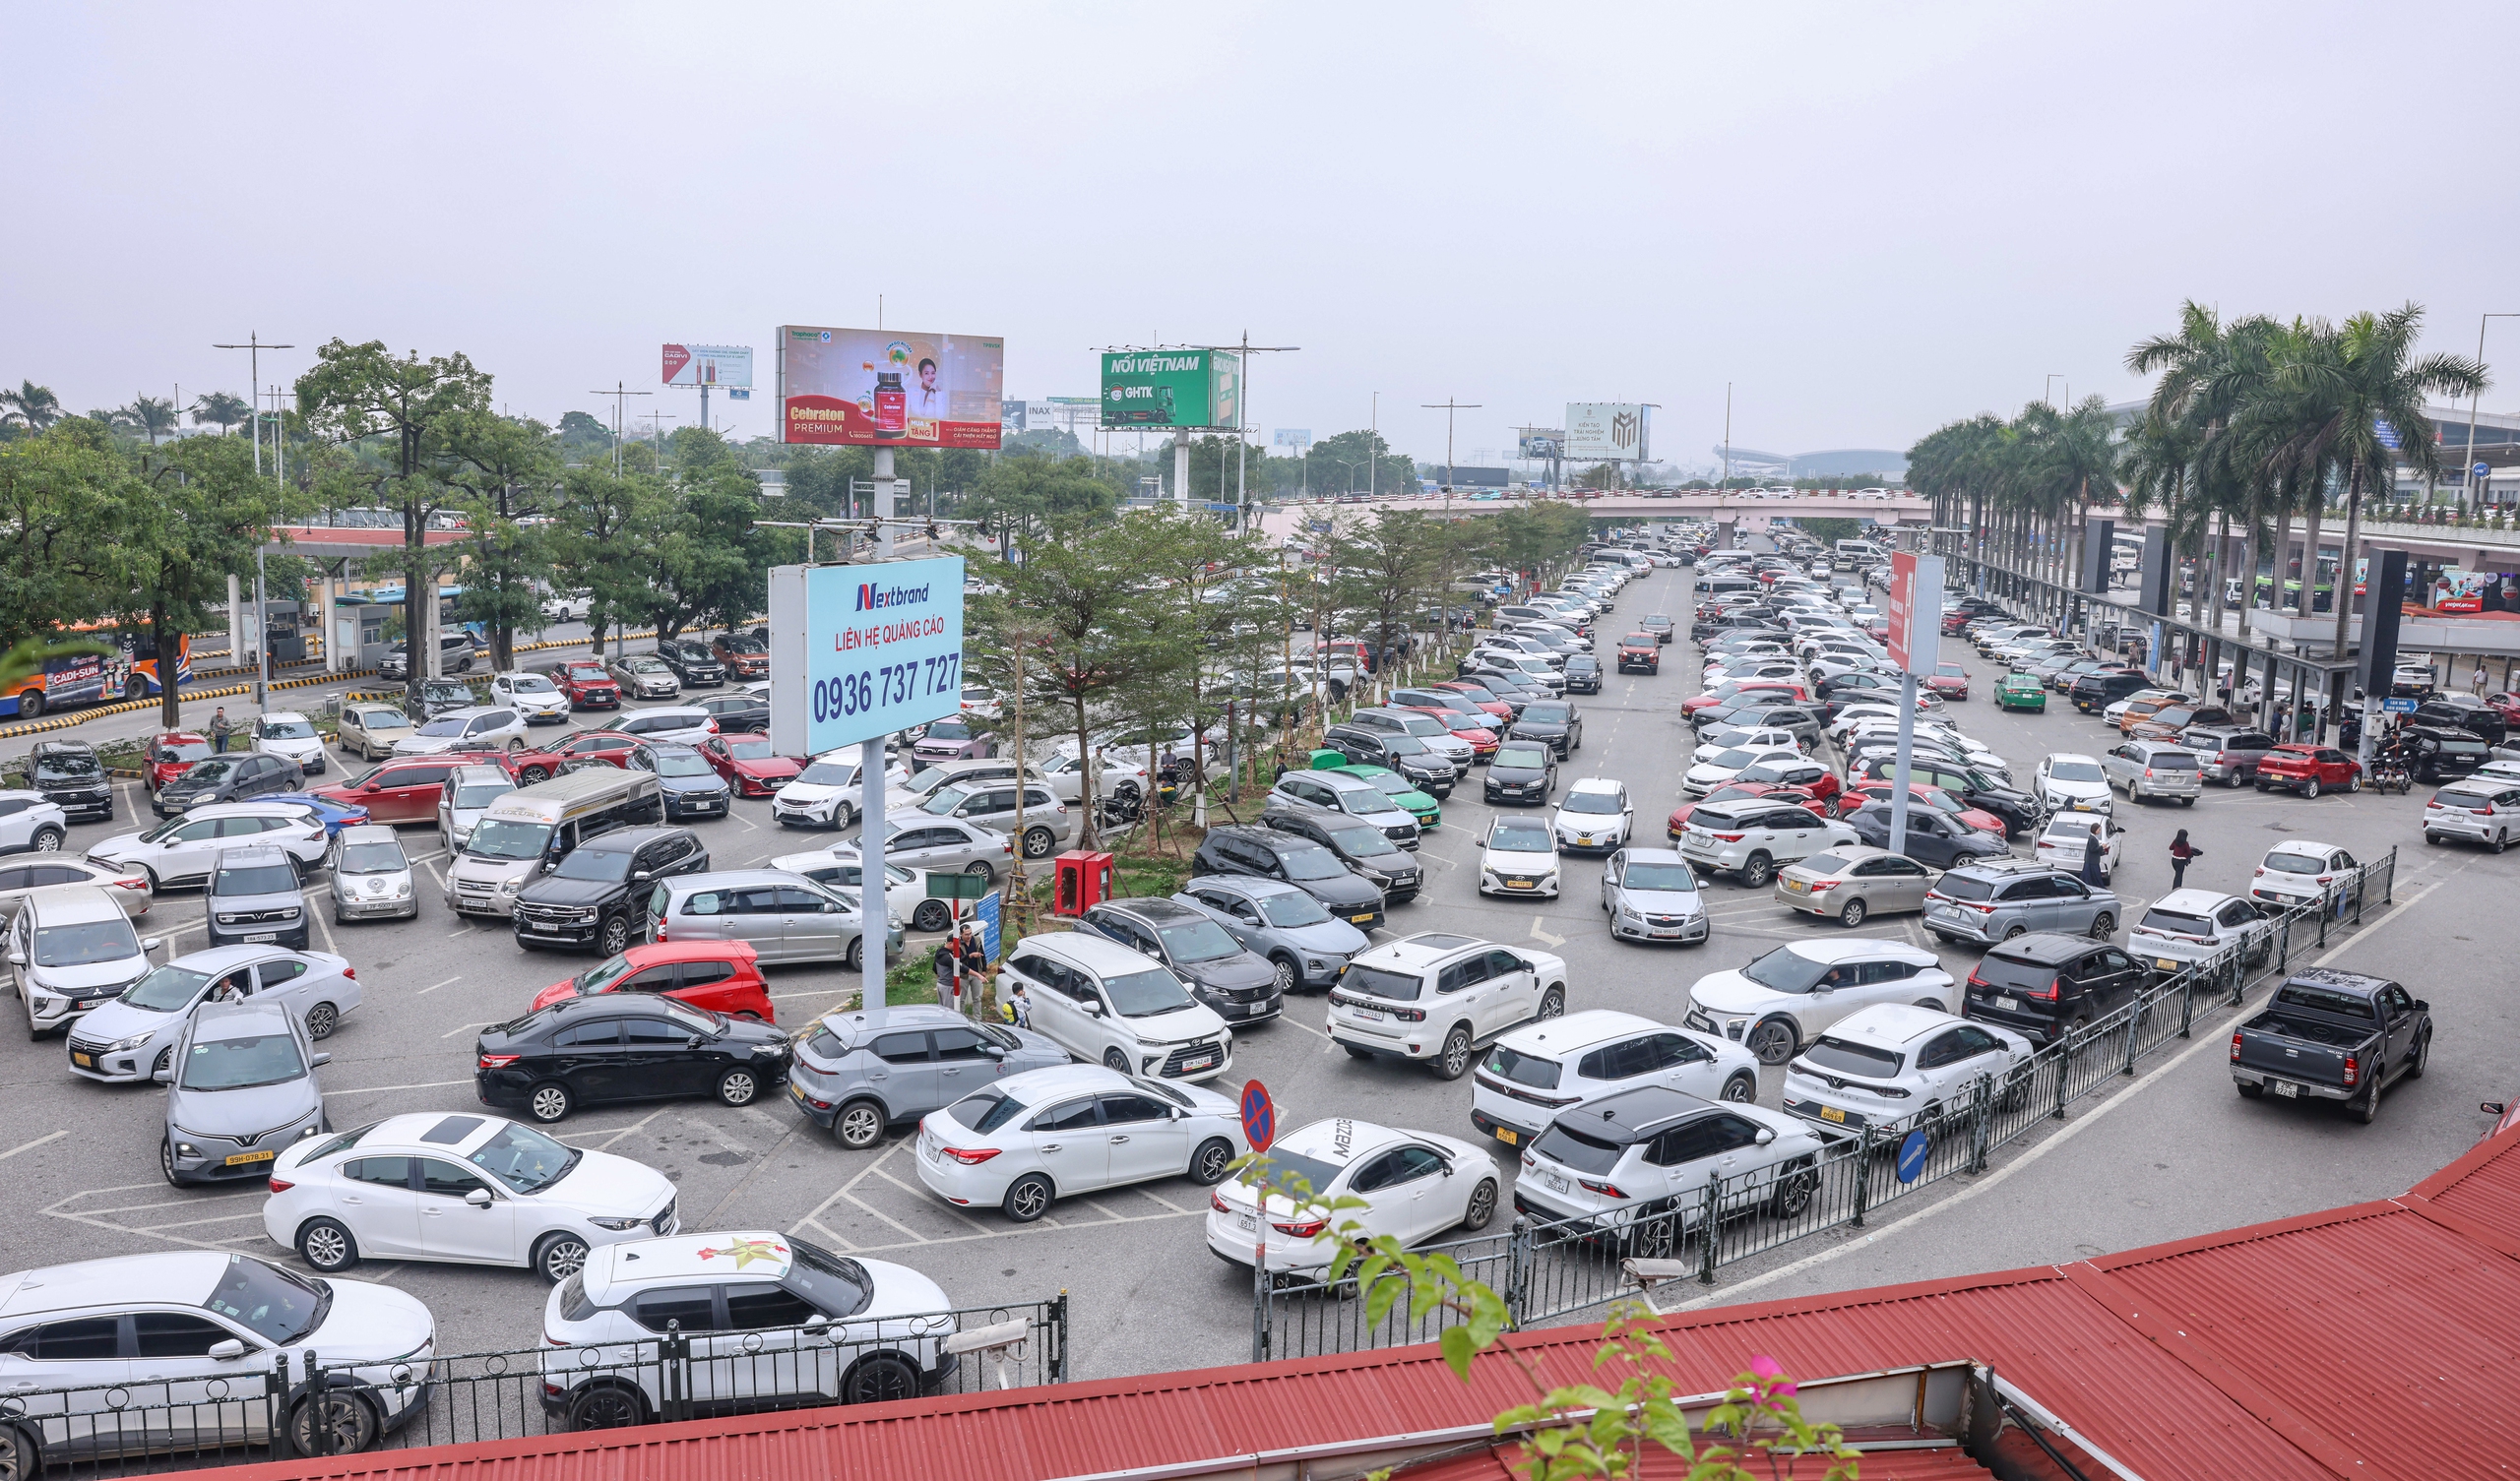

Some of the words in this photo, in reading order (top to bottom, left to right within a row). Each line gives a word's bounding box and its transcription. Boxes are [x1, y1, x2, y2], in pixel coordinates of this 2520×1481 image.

[1110, 352, 1136, 373] NỐI
[1125, 386, 1153, 399] GHTK
[790, 406, 845, 421] Cebraton
[794, 423, 843, 433] PREMIUM
[912, 428, 930, 437] TẶNG
[930, 422, 936, 437] 1
[854, 583, 929, 612] Nextbrand
[836, 626, 861, 651] LIÊN
[865, 625, 880, 649] HỆ
[882, 618, 920, 644] QUẢNG
[923, 613, 944, 637] CÁO
[53, 664, 98, 685] CADI-SUN
[813, 670, 872, 723] 0936
[880, 660, 918, 708] 737
[925, 652, 960, 696] 727
[493, 809, 546, 819] LUXURY
[1346, 999, 1388, 1011] EVEREST
[229, 1152, 270, 1164] 99H-078.31
